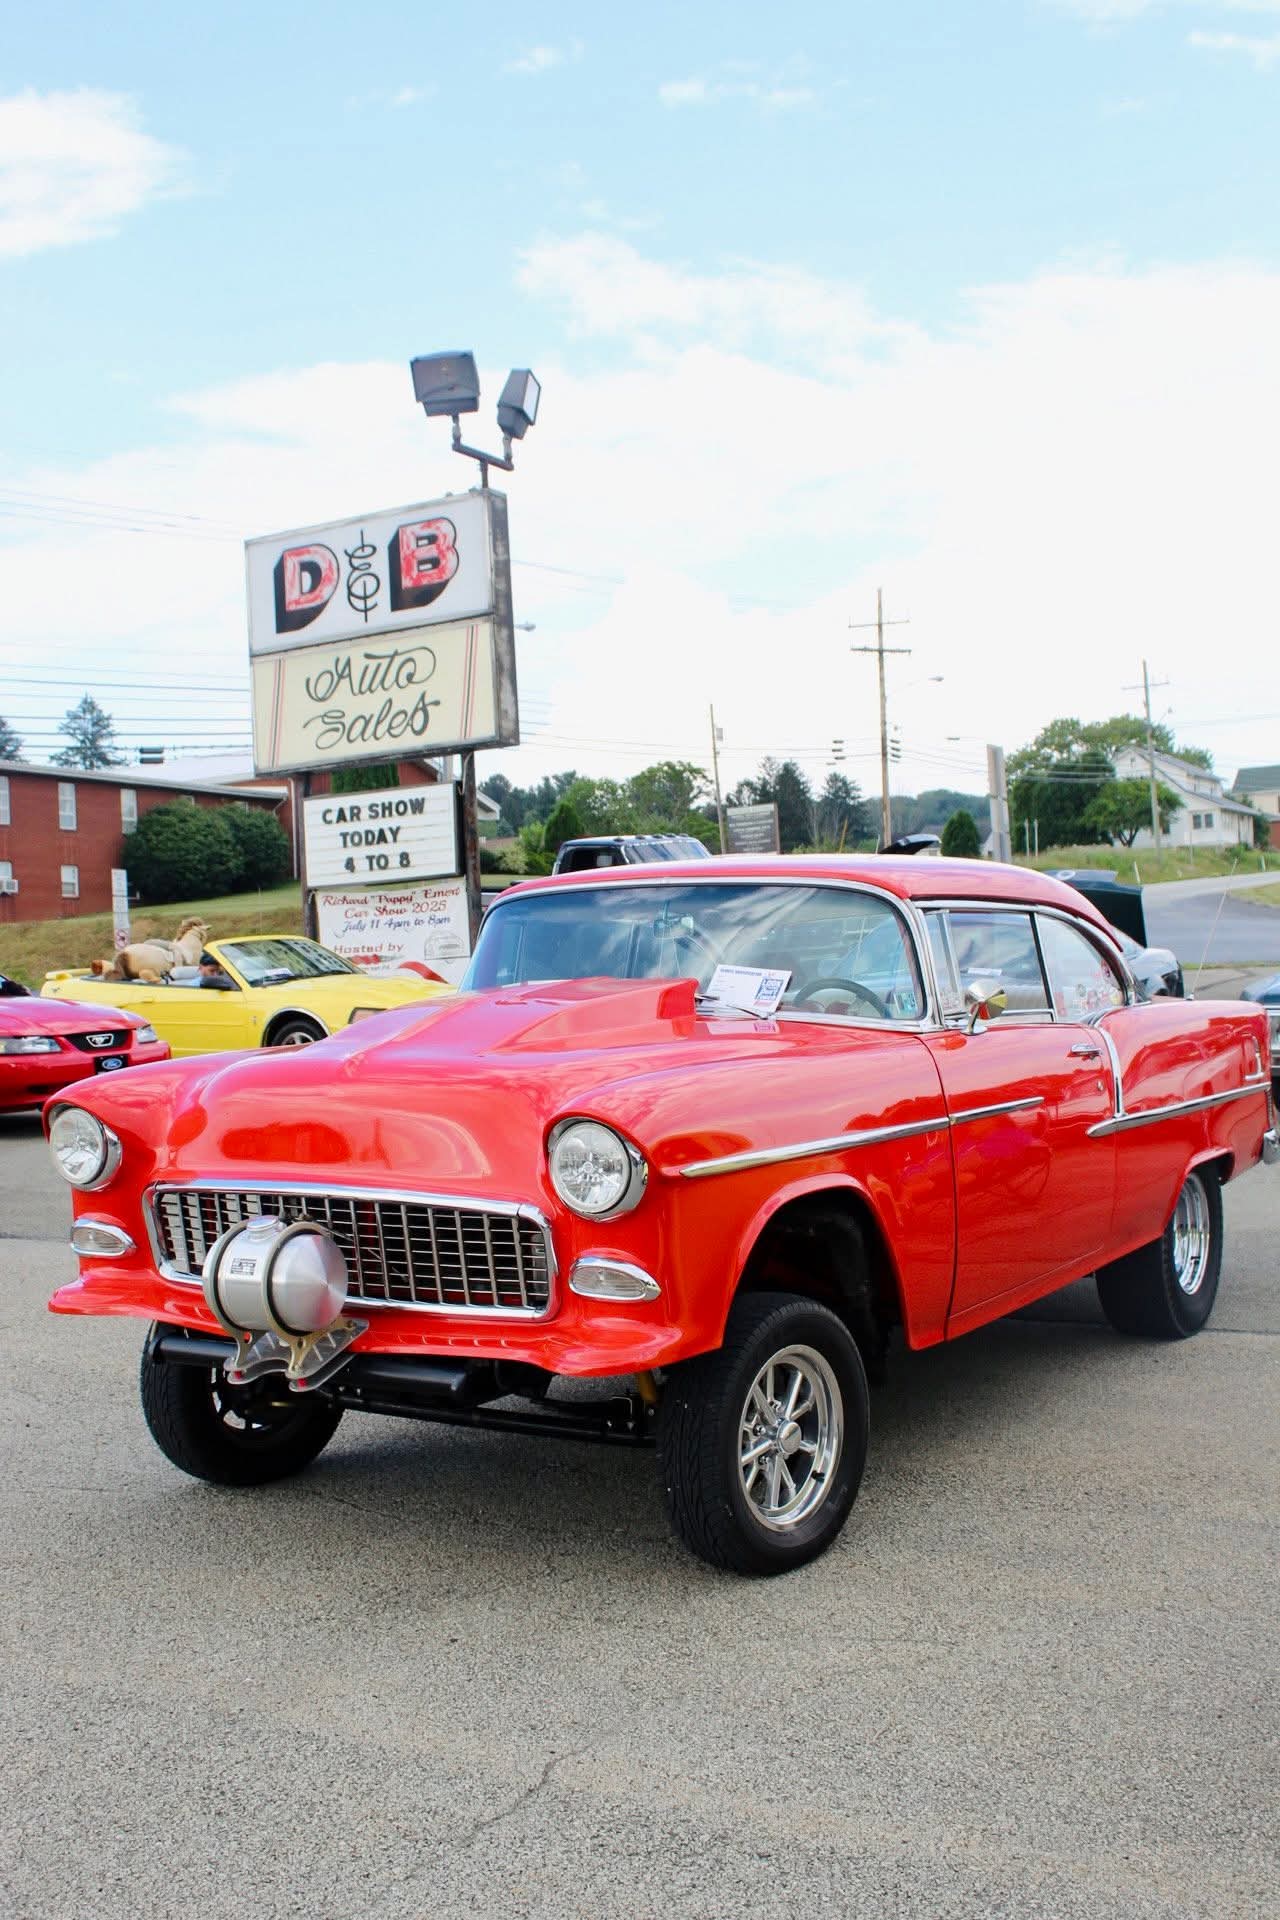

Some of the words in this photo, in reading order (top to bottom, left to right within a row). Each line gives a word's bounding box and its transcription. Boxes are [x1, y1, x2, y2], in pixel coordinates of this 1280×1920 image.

[305, 646, 437, 703] Auto
[303, 690, 441, 750] Sales
[321, 805, 362, 825] CAR
[367, 796, 426, 820] SHOW
[339, 825, 401, 849] TODAY
[344, 856, 356, 873] 4
[365, 853, 389, 872] TO
[399, 851, 411, 868] 8
[321, 894, 369, 906] Richard
[343, 907, 368, 919] Car
[374, 904, 407, 917] Show
[411, 899, 448, 914] 2025
[335, 919, 367, 937] July
[370, 917, 380, 929] 11
[384, 916, 411, 930] 4pm
[414, 915, 425, 926] to
[428, 914, 451, 927] 8pm
[333, 943, 383, 954] Hosted
[387, 942, 405, 953] by
